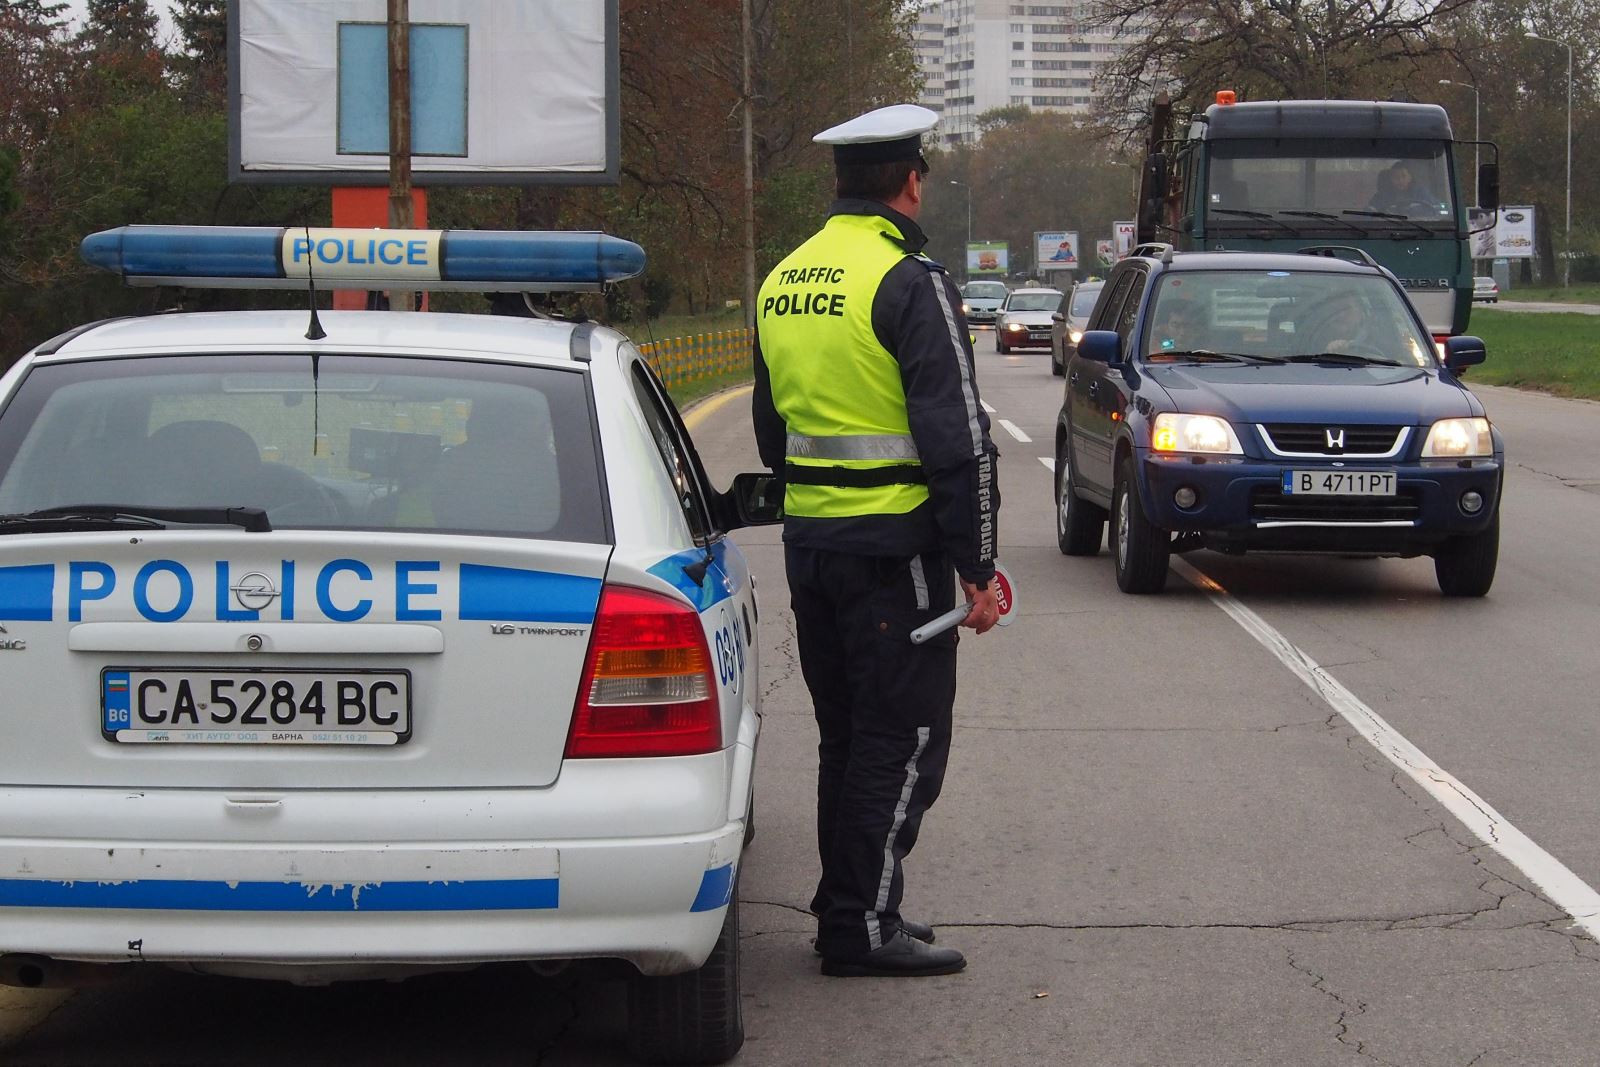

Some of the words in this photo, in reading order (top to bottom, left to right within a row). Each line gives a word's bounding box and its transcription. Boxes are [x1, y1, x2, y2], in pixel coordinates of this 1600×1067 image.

[293, 238, 428, 265] POLICE
[779, 268, 845, 286] TRAFFIC
[763, 293, 846, 319] POLICE
[978, 453, 992, 512] TRAFFIC
[1301, 473, 1313, 492] B
[980, 512, 993, 562] POLICE
[68, 558, 442, 622] POLICE
[518, 626, 587, 636] TWINPORT
[108, 708, 128, 722] BG
[138, 679, 199, 724] CA
[211, 680, 326, 725] 5284
[337, 681, 399, 726] BC
[271, 733, 304, 741] ВАРНА
